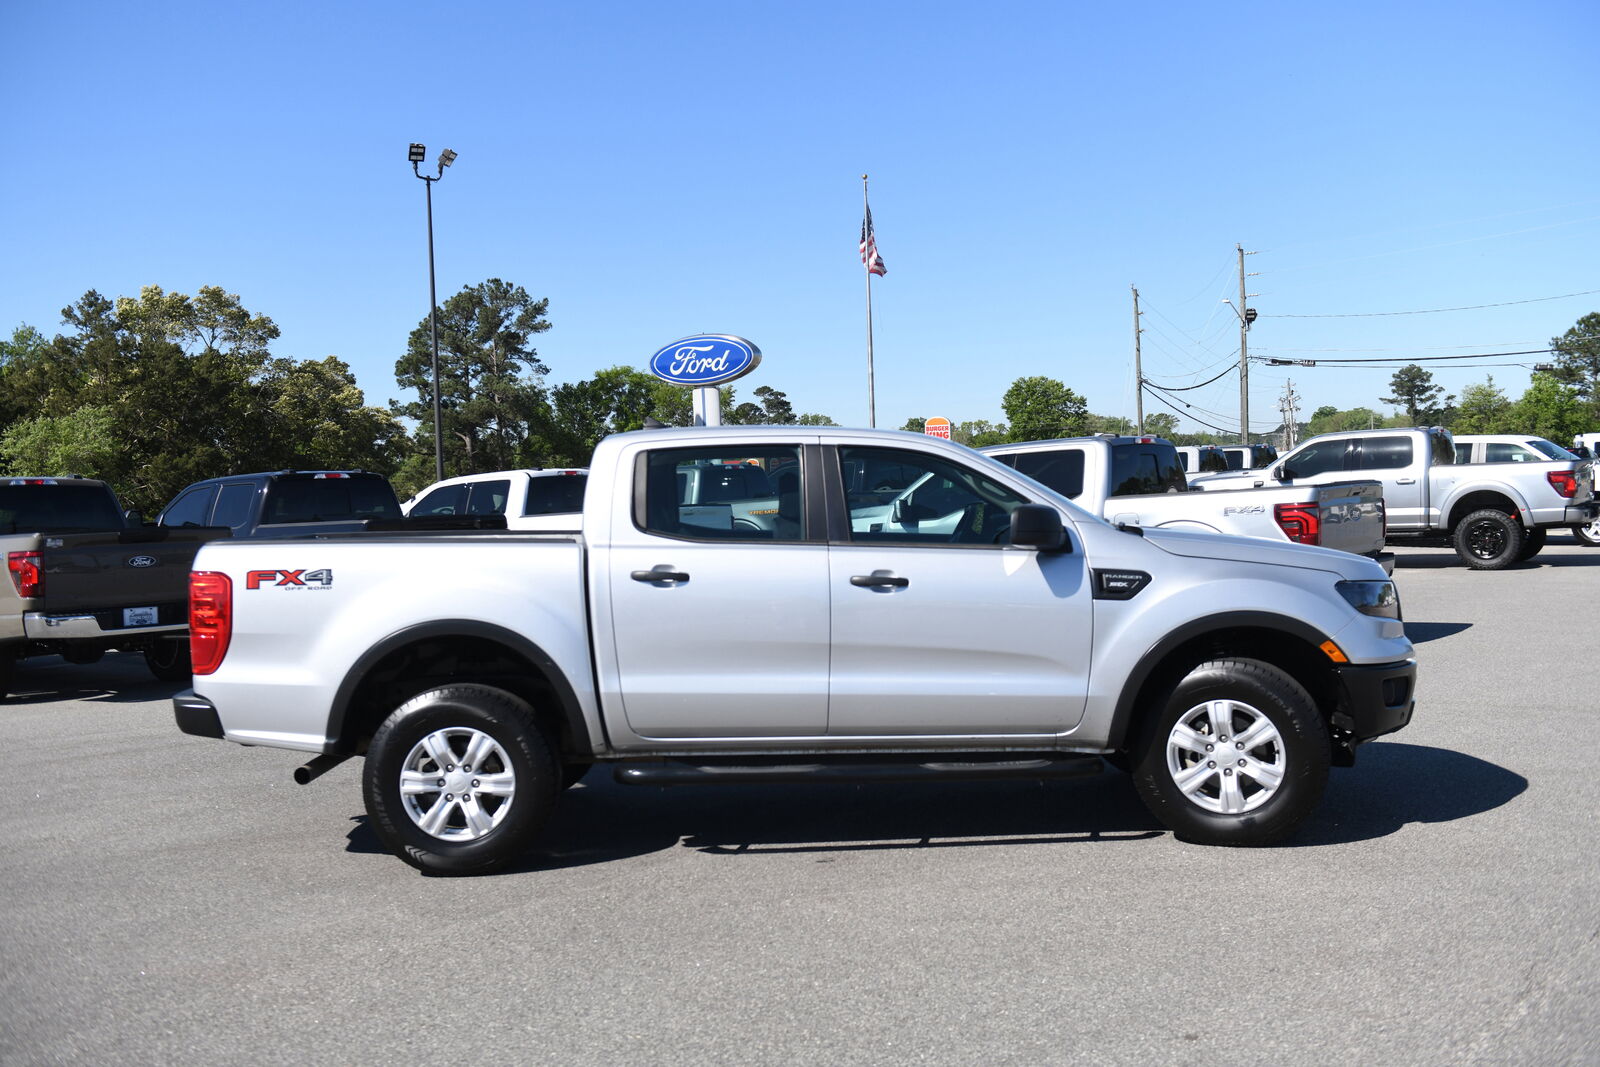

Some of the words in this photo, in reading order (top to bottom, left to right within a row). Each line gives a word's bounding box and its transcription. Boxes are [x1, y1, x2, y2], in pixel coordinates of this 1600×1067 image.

[669, 345, 731, 376] Ford
[1224, 504, 1265, 516] FX4
[131, 556, 153, 567] Ford
[246, 569, 333, 590] FX4
